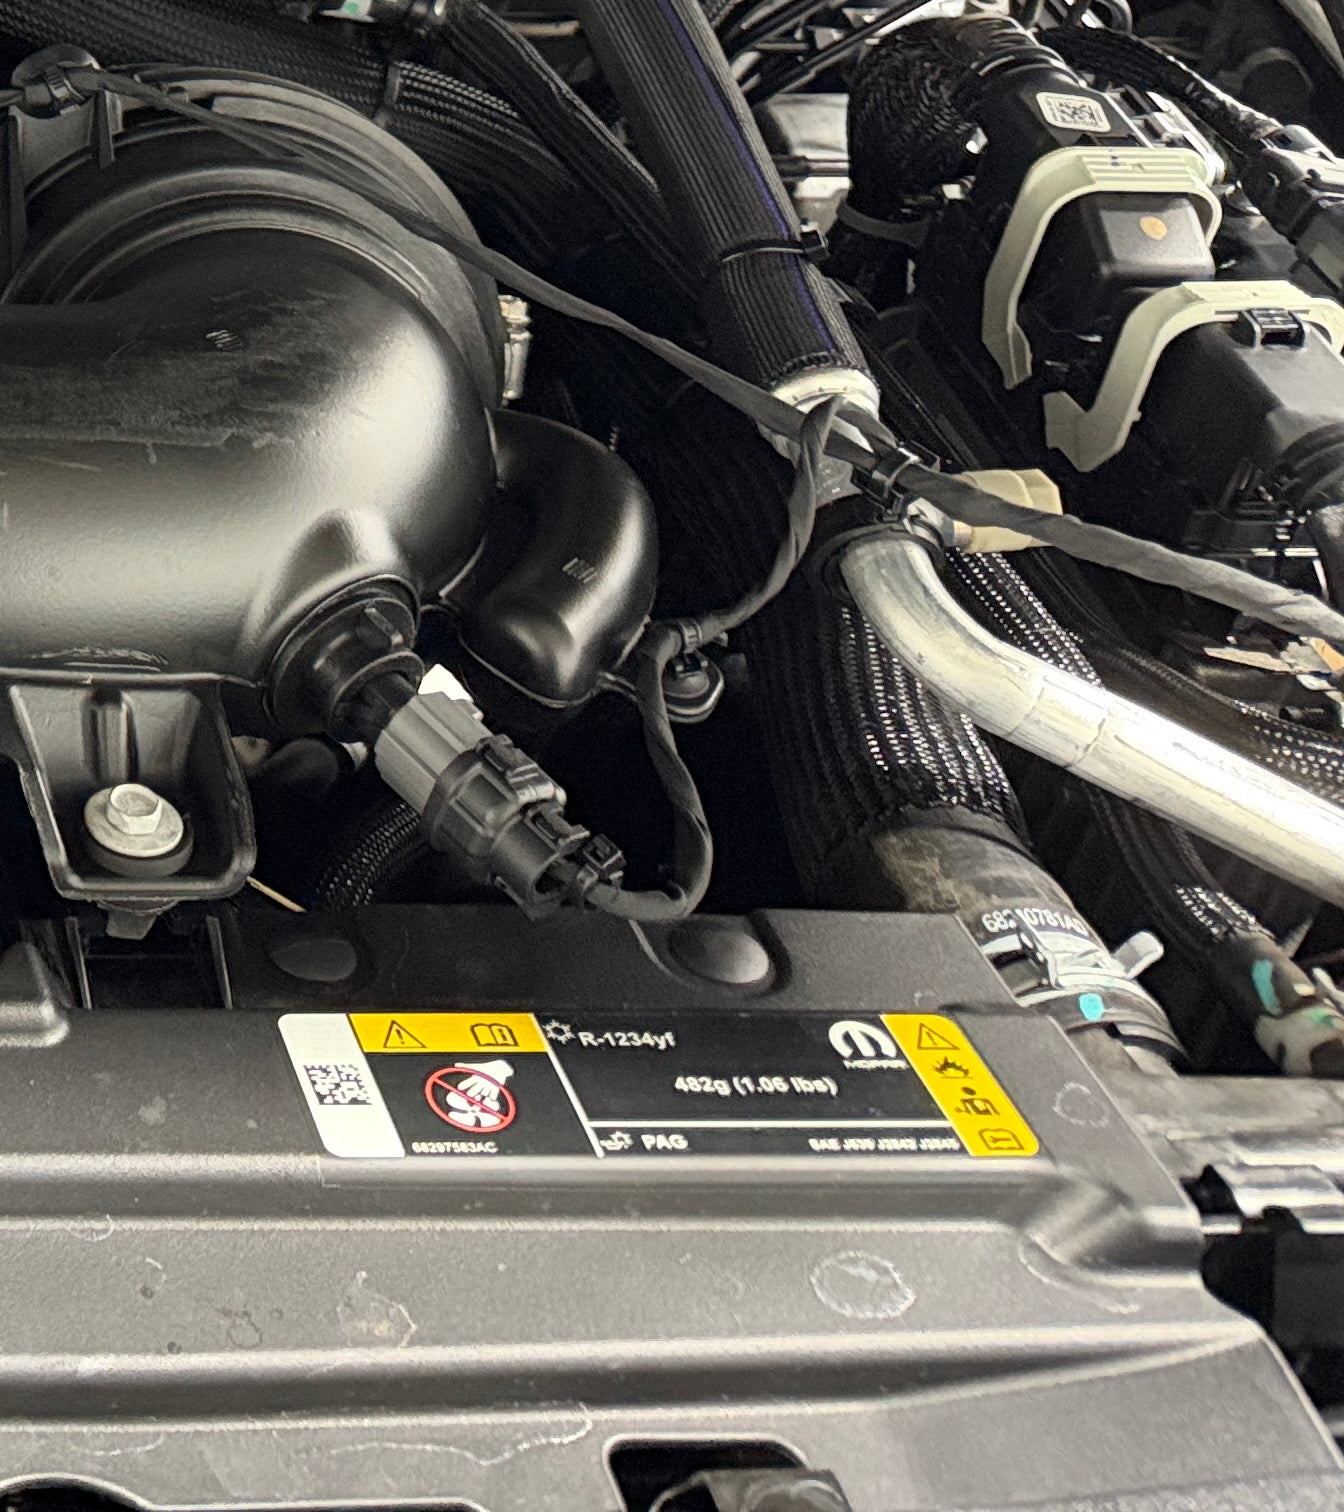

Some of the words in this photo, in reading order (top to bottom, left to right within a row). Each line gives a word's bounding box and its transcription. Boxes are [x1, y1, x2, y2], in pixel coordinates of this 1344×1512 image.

[577, 1031, 678, 1052] R-1234yf
[842, 1059, 910, 1072] MOPAR
[673, 1076, 731, 1098] 482g
[733, 1075, 786, 1097] (1.06
[789, 1075, 839, 1098] lbs)
[640, 1133, 690, 1151] PAG
